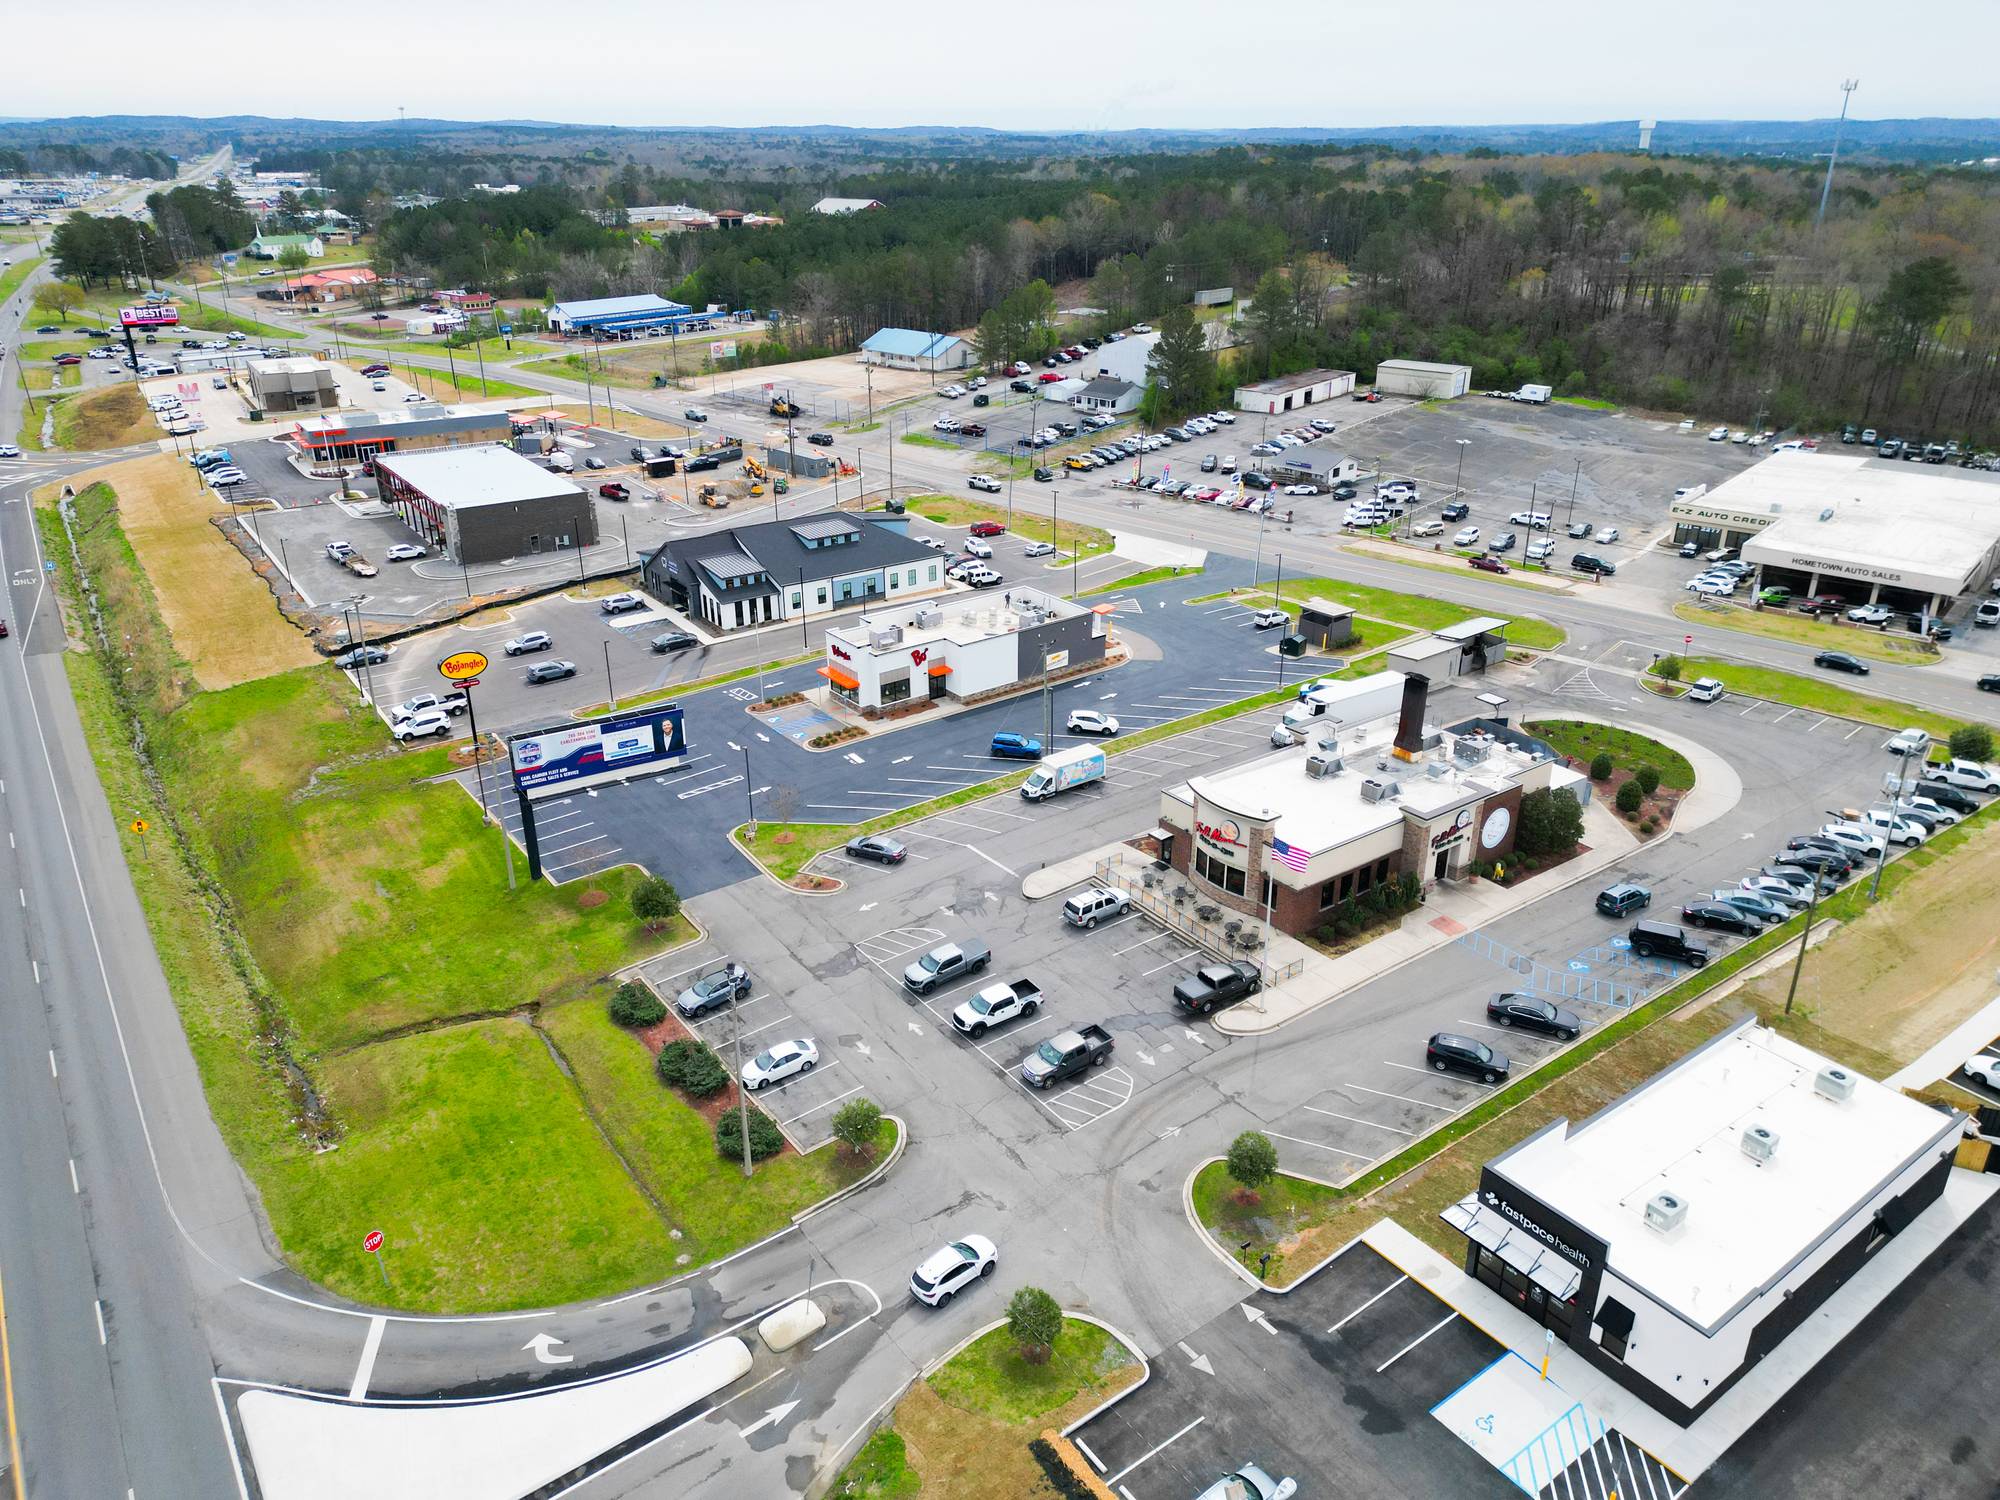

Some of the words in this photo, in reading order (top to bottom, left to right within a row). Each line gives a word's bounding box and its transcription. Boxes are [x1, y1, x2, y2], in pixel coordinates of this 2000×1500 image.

[136, 308, 161, 318] BEST
[1671, 506, 1694, 515] E-Z
[1697, 510, 1729, 521] AUTO
[1791, 557, 1843, 572] HOMETOWN
[1844, 566, 1870, 577] AUTO
[1871, 570, 1902, 582] SALES
[12, 578, 37, 586] ONLY
[444, 659, 484, 674] Bojangles
[521, 777, 547, 786] COMMERCIAL
[532, 771, 548, 780] CANNON
[365, 1233, 382, 1249] STOP
